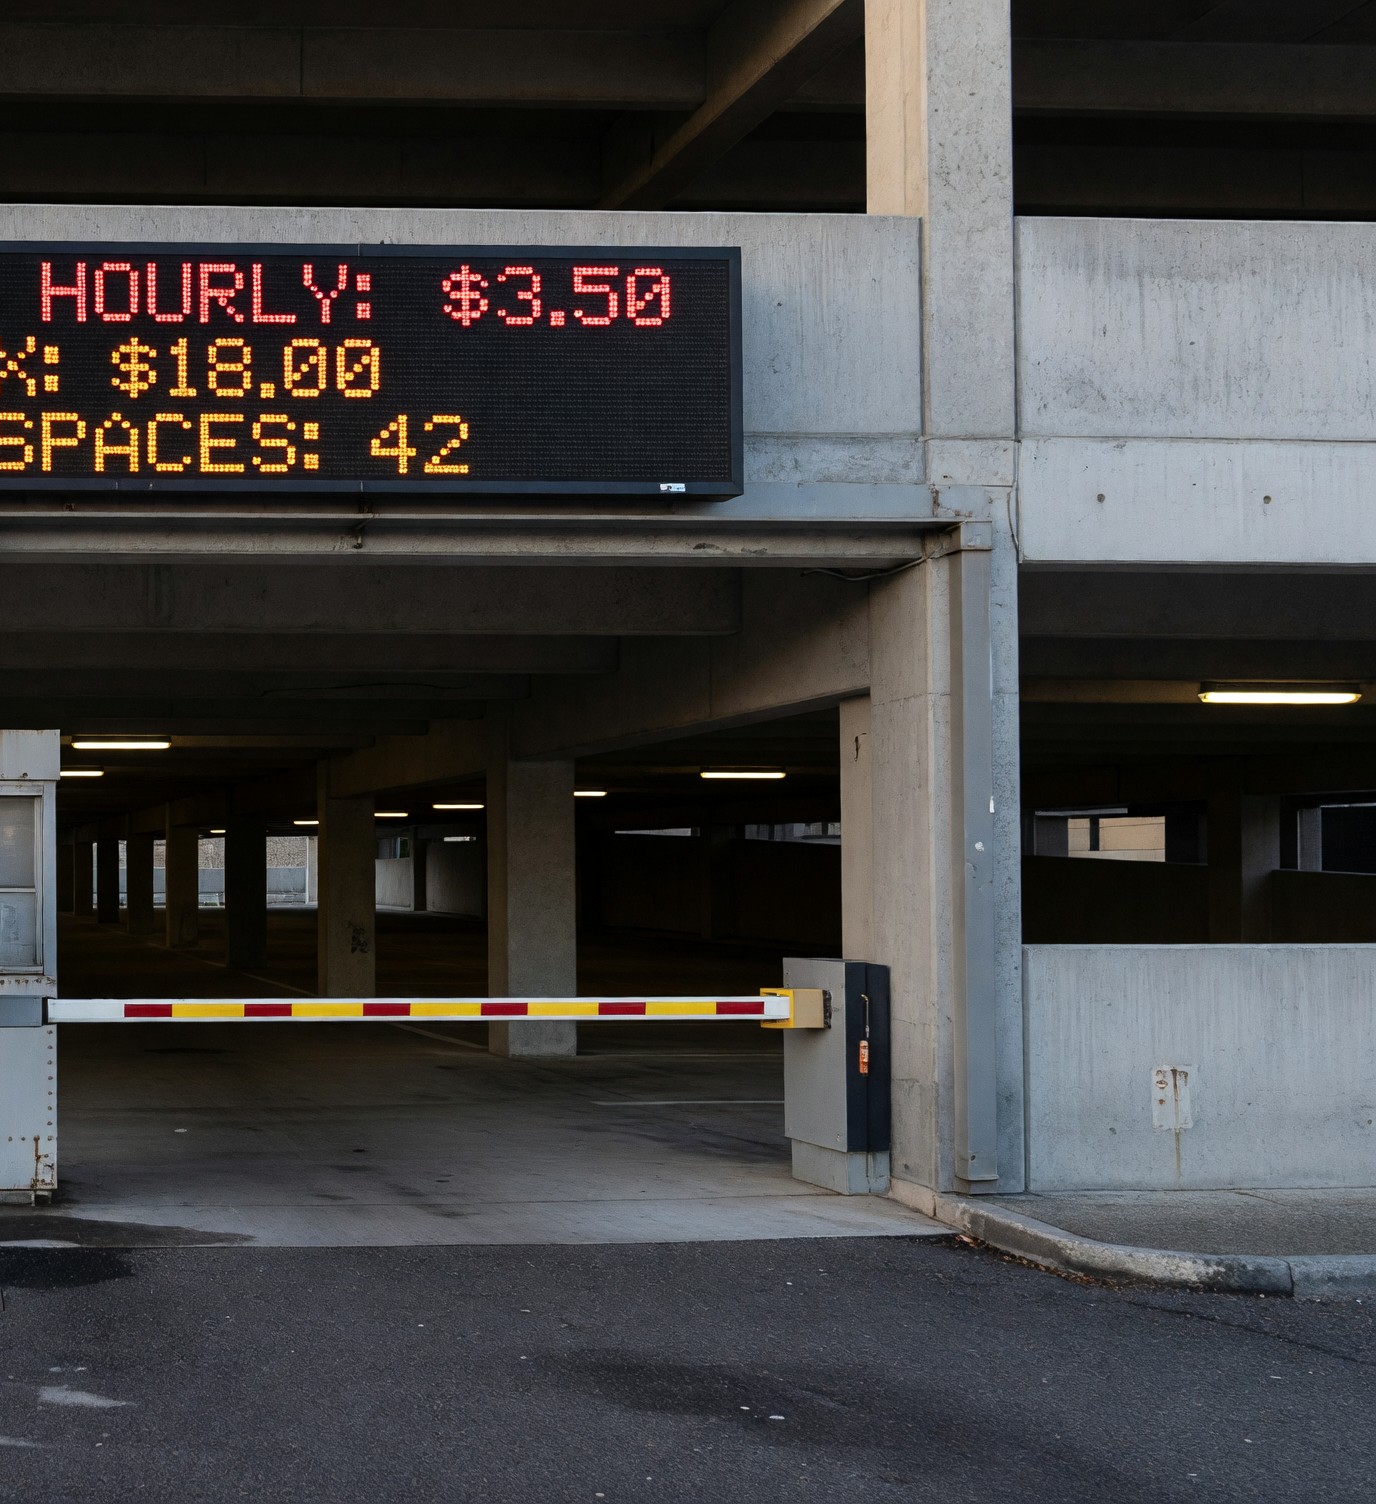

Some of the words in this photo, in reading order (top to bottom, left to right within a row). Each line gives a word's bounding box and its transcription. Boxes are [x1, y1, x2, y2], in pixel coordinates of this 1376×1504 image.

[41, 262, 371, 324] HOURLY:
[442, 265, 672, 327] $3.50
[111, 337, 380, 398] $18.00
[370, 414, 469, 474] 42
